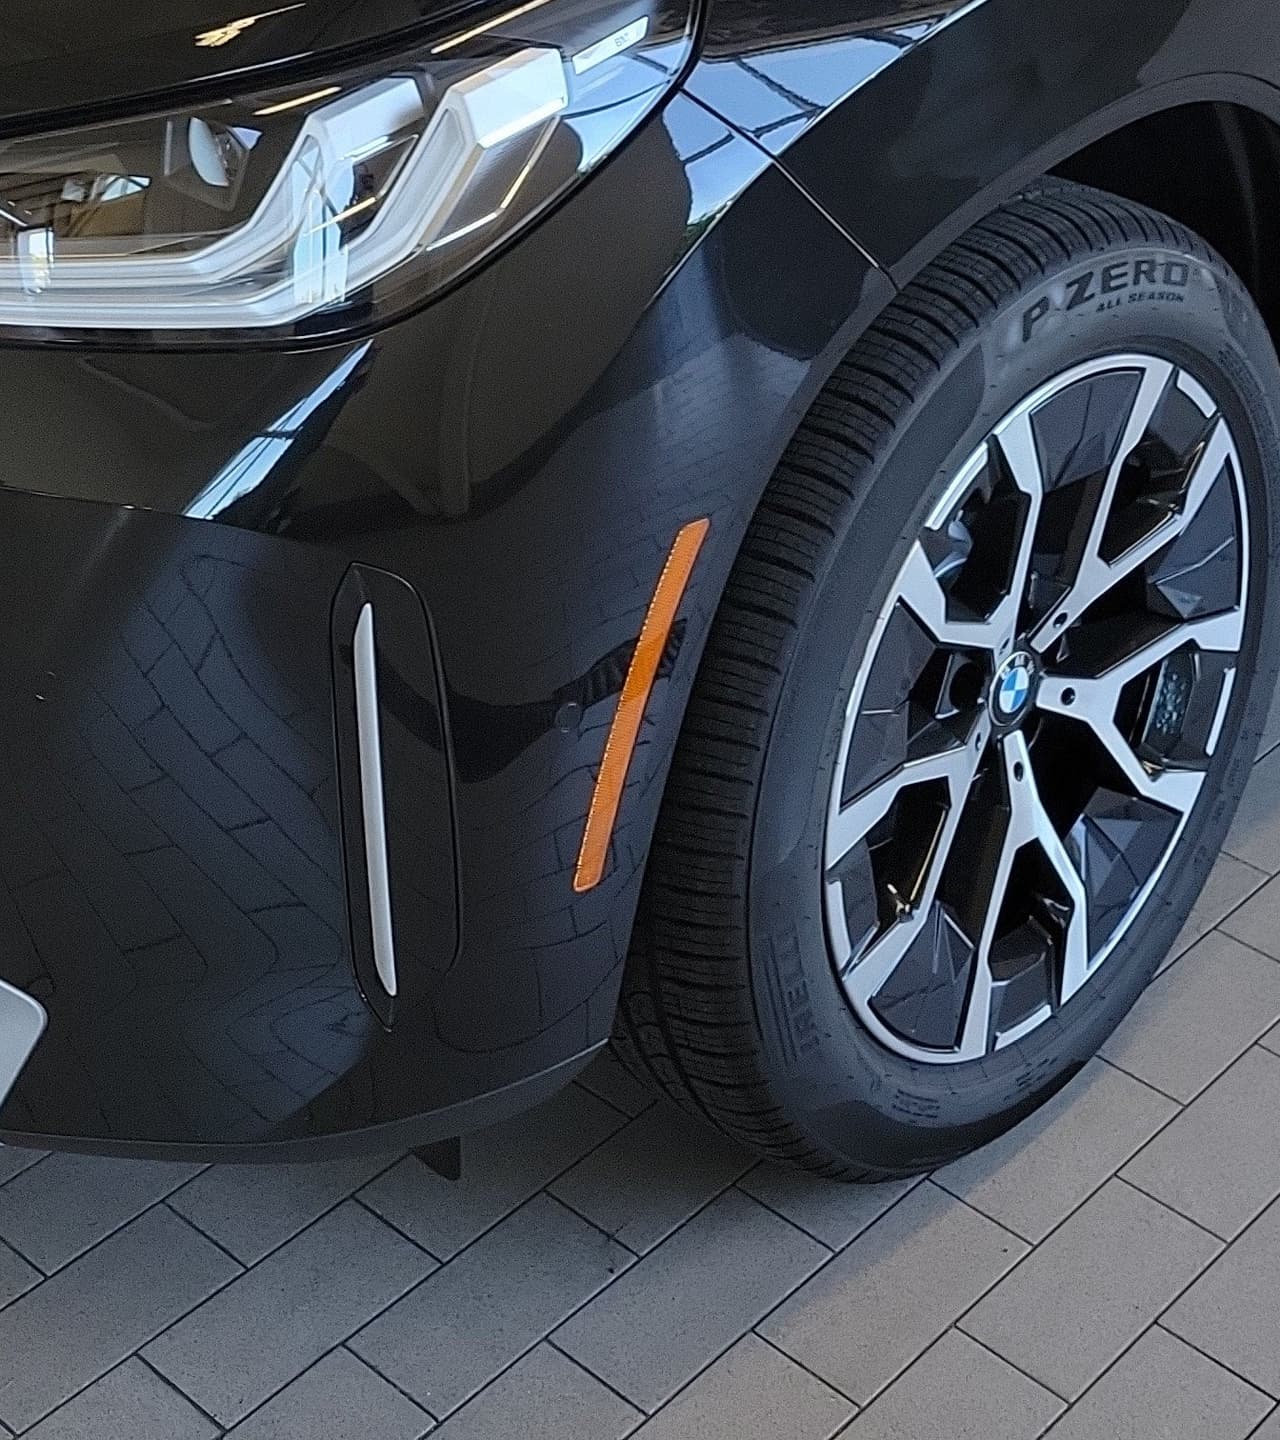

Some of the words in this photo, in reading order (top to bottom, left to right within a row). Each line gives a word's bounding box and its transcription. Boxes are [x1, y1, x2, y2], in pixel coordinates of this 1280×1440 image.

[1022, 296, 1050, 343] P
[1065, 260, 1190, 311] ZERO
[1127, 291, 1185, 304] SEASON
